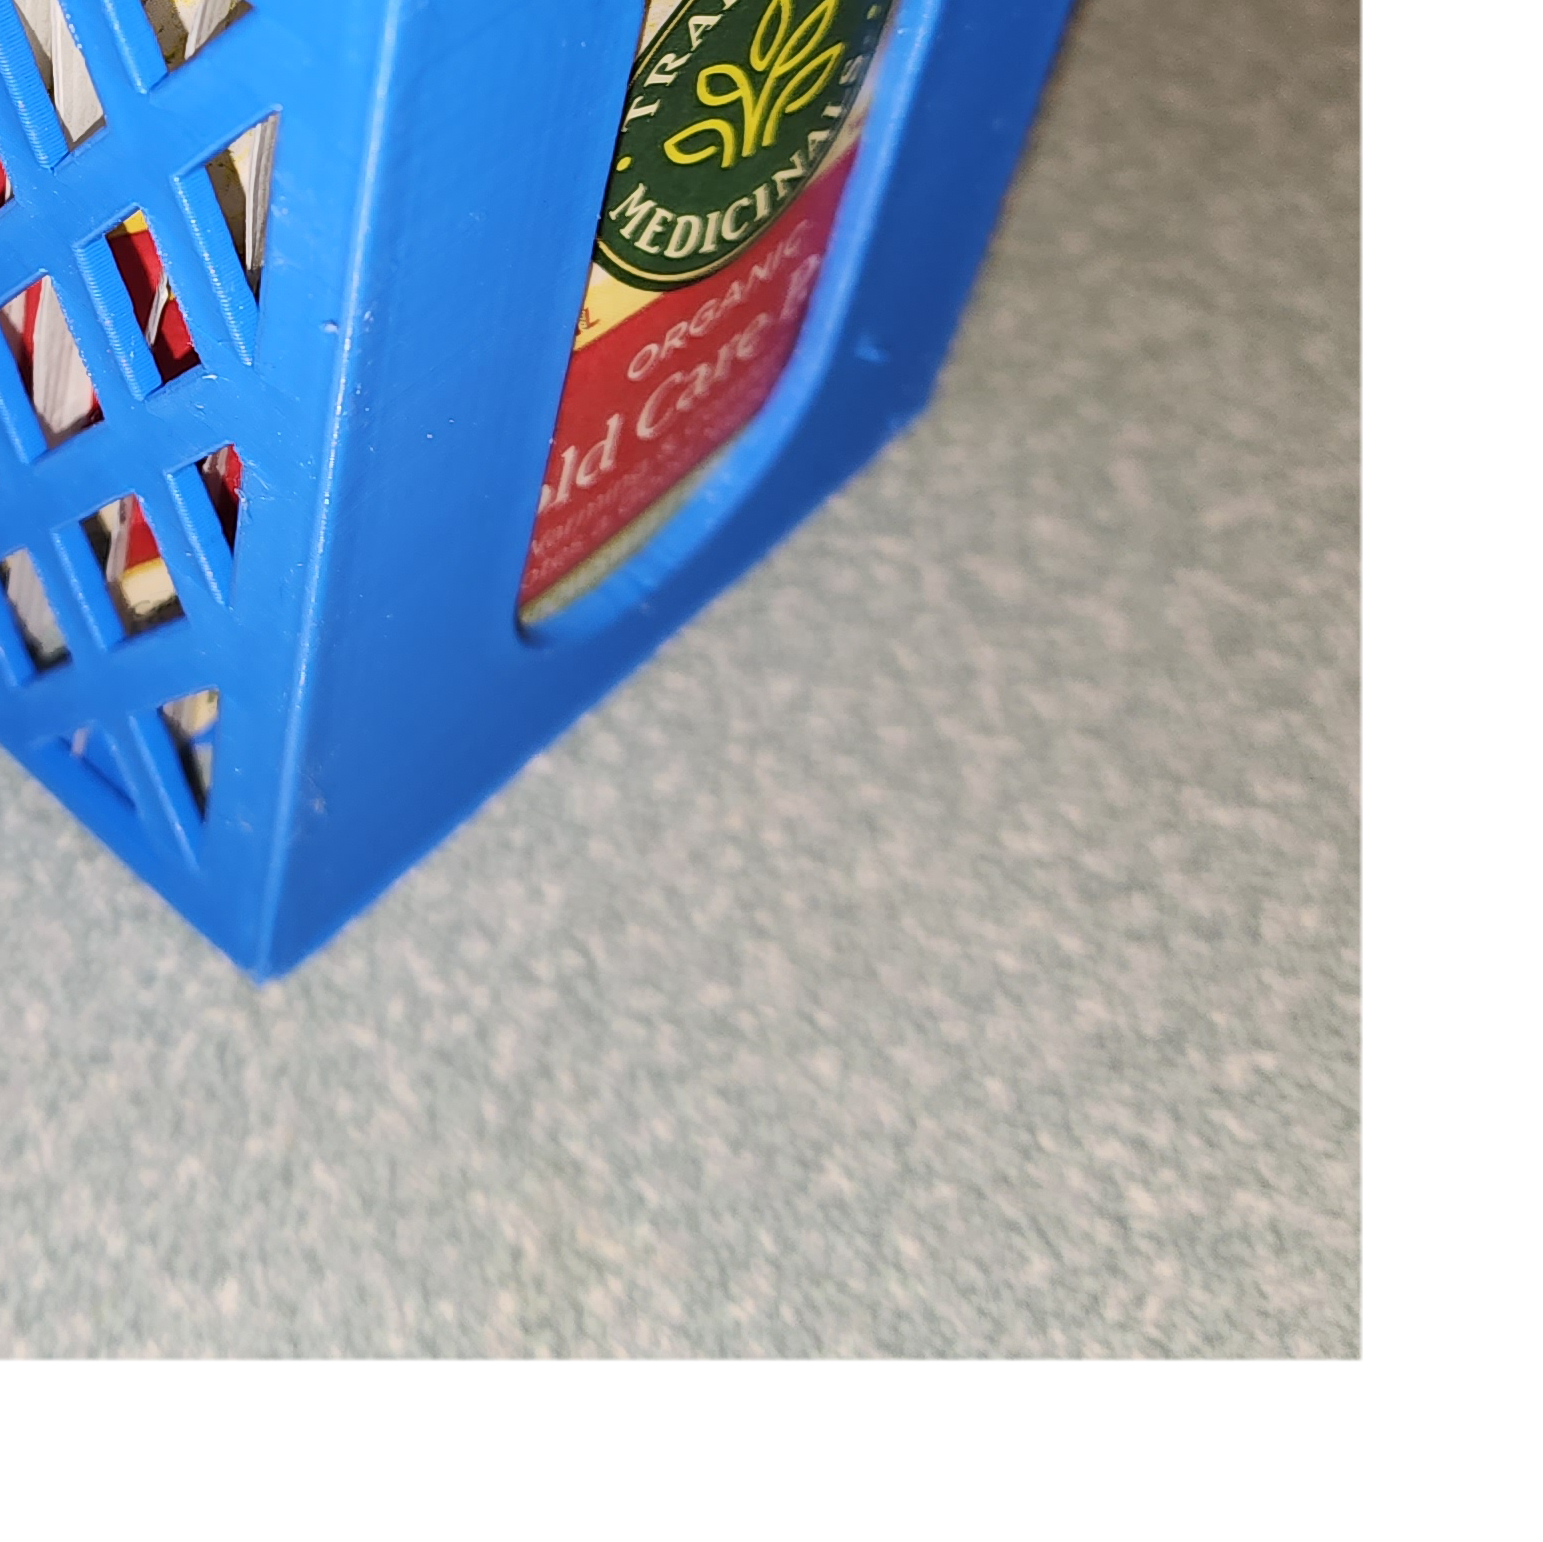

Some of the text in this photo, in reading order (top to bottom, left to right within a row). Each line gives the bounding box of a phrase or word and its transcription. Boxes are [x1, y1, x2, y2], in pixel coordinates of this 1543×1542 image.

[608, 54, 864, 258] MEDICINALS
[627, 219, 812, 381] ORGANIC
[636, 312, 771, 439] Care
